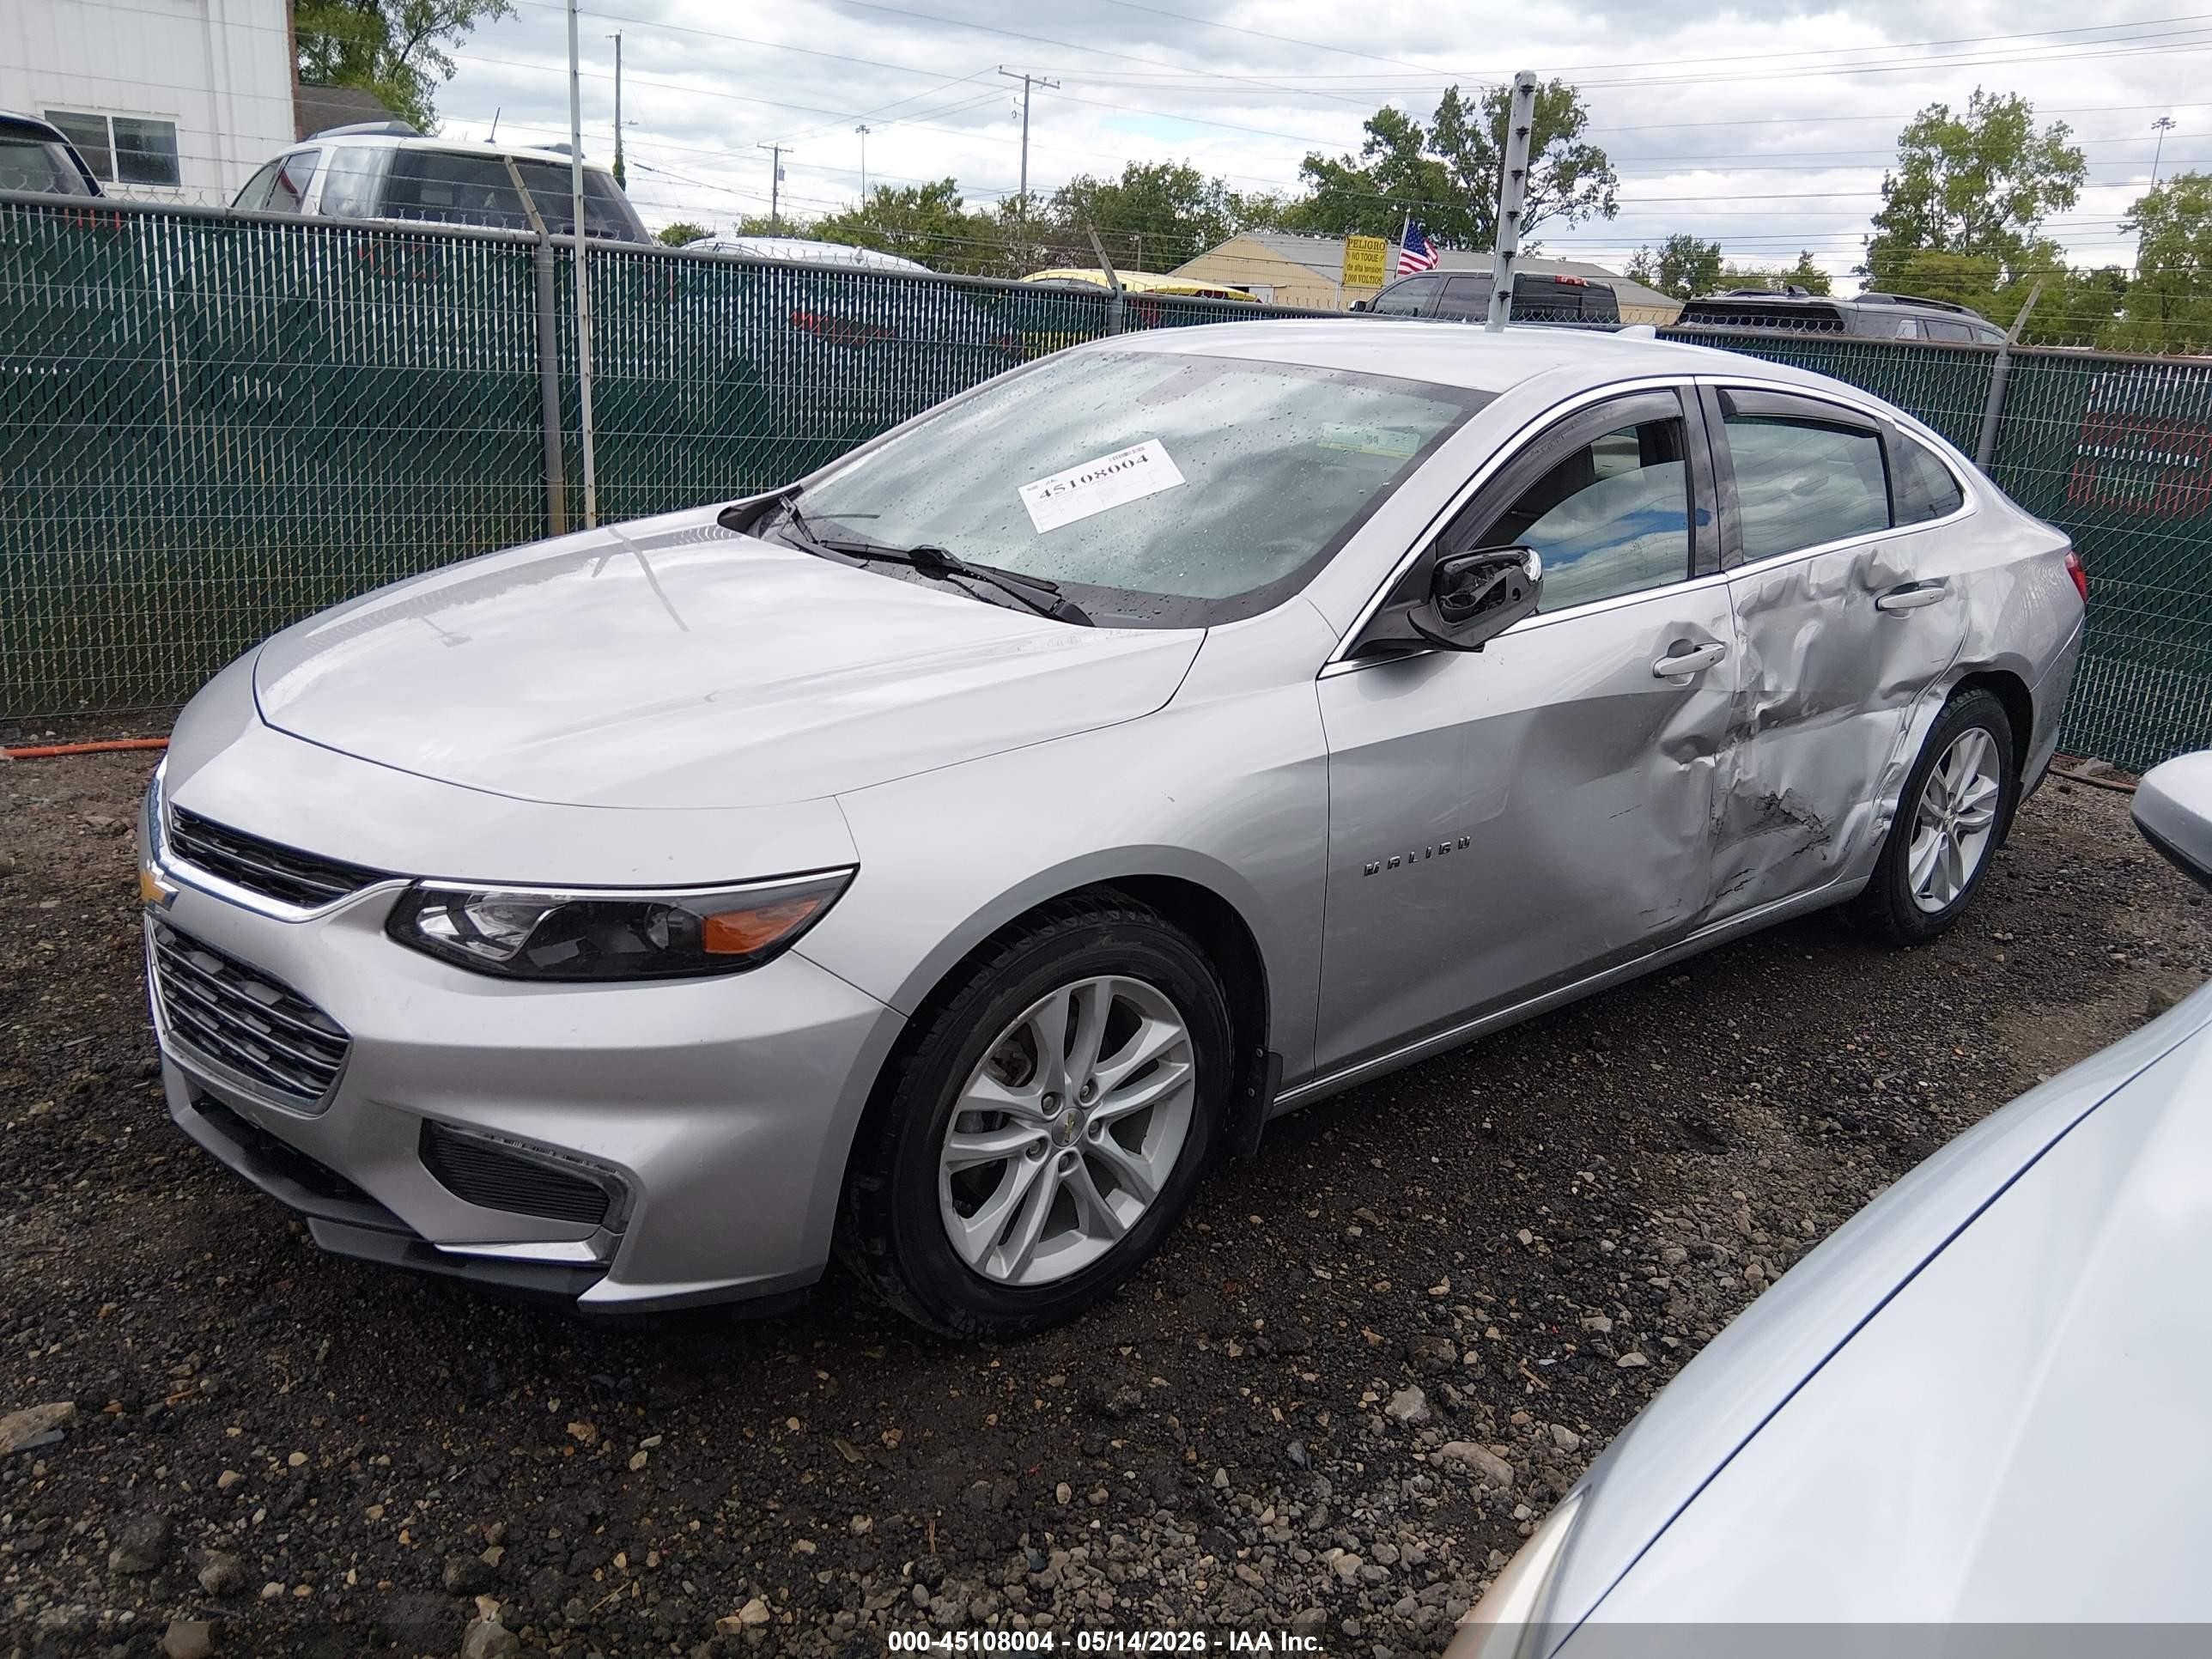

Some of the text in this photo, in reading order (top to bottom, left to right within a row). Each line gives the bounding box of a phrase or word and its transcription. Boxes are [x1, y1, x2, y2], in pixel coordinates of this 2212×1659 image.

[1347, 239, 1385, 251] PELIGRO
[1360, 253, 1378, 262] TOQUE
[1358, 274, 1382, 285] VOLTIOS
[1039, 454, 1149, 499] 45108004
[1364, 836, 1471, 877] MALIBU
